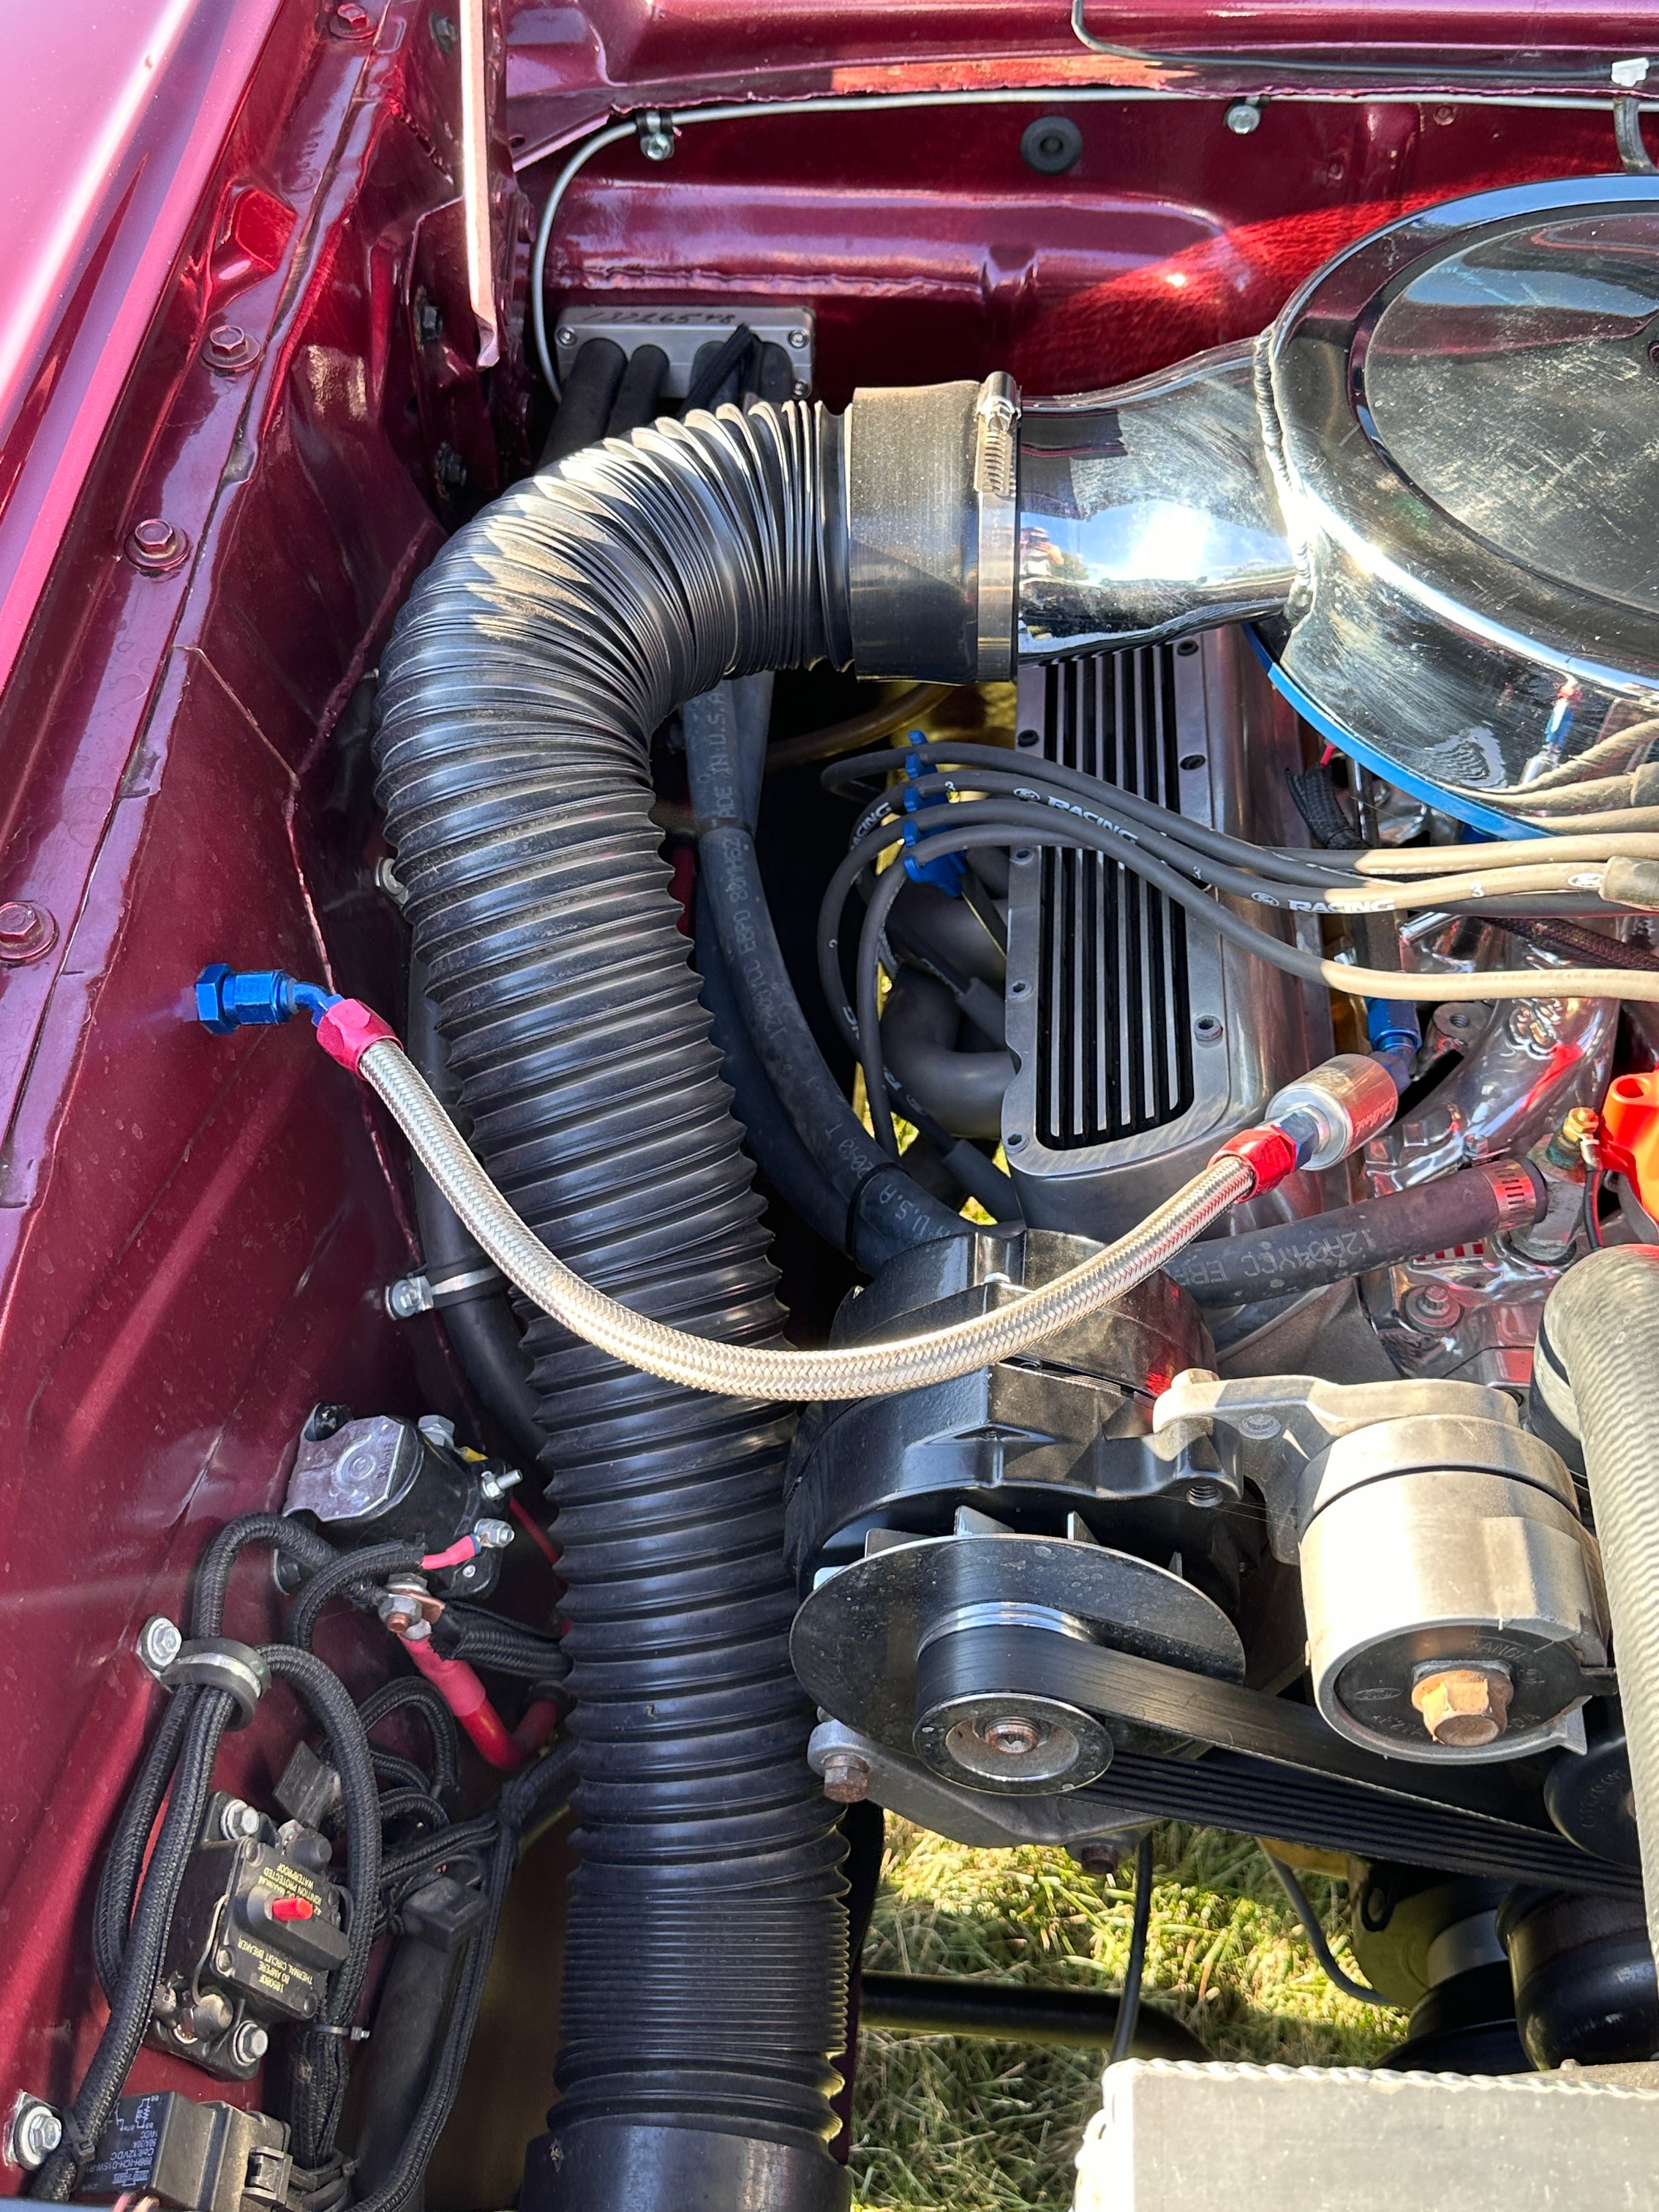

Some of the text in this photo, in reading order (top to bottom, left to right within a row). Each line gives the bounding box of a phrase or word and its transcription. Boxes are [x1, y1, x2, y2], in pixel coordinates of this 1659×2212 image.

[849, 802, 891, 851] ACING
[1047, 795, 1139, 845] RACING
[1470, 882, 1484, 898] 3
[1289, 899, 1396, 914] RACING
[1162, 1259, 1227, 1286] EBP
[263, 1866, 323, 1905] IGNITION PROTECTED
[276, 1863, 315, 1889] WATERPROOF
[236, 1938, 313, 1985] THERMAL CIRCUIT BREAKER
[257, 1960, 282, 1980] AMPERE
